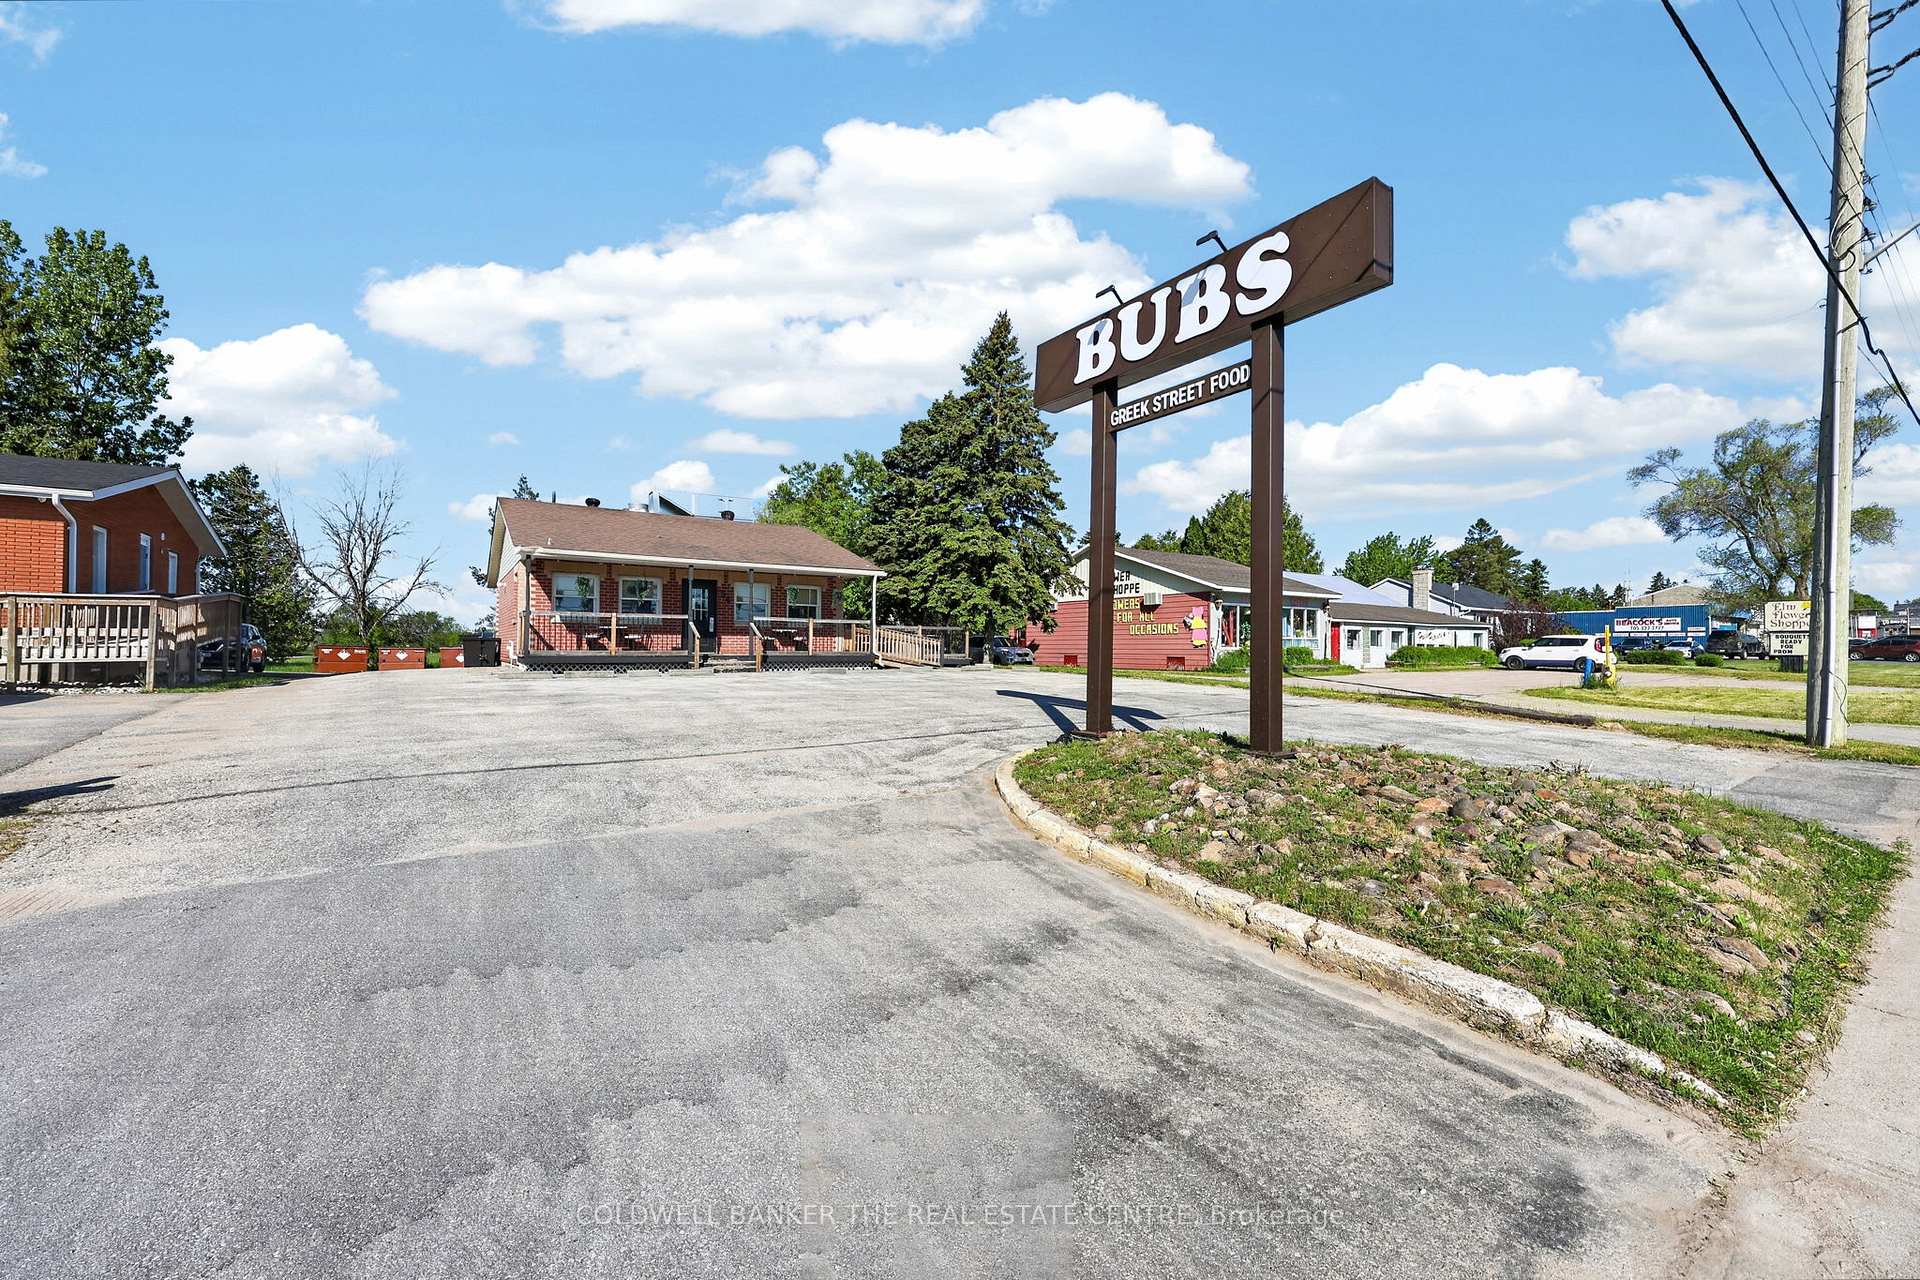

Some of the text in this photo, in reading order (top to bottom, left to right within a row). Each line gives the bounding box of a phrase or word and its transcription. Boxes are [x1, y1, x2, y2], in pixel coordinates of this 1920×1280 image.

[1073, 231, 1293, 385] BUBS
[1110, 365, 1250, 426] GREEK STREET FOOD
[1113, 570, 1131, 582] WER
[1113, 583, 1140, 595] HOPPE
[1113, 598, 1140, 610] OWERS
[1116, 611, 1133, 623] FOR
[1129, 624, 1179, 635] OCCASIONS
